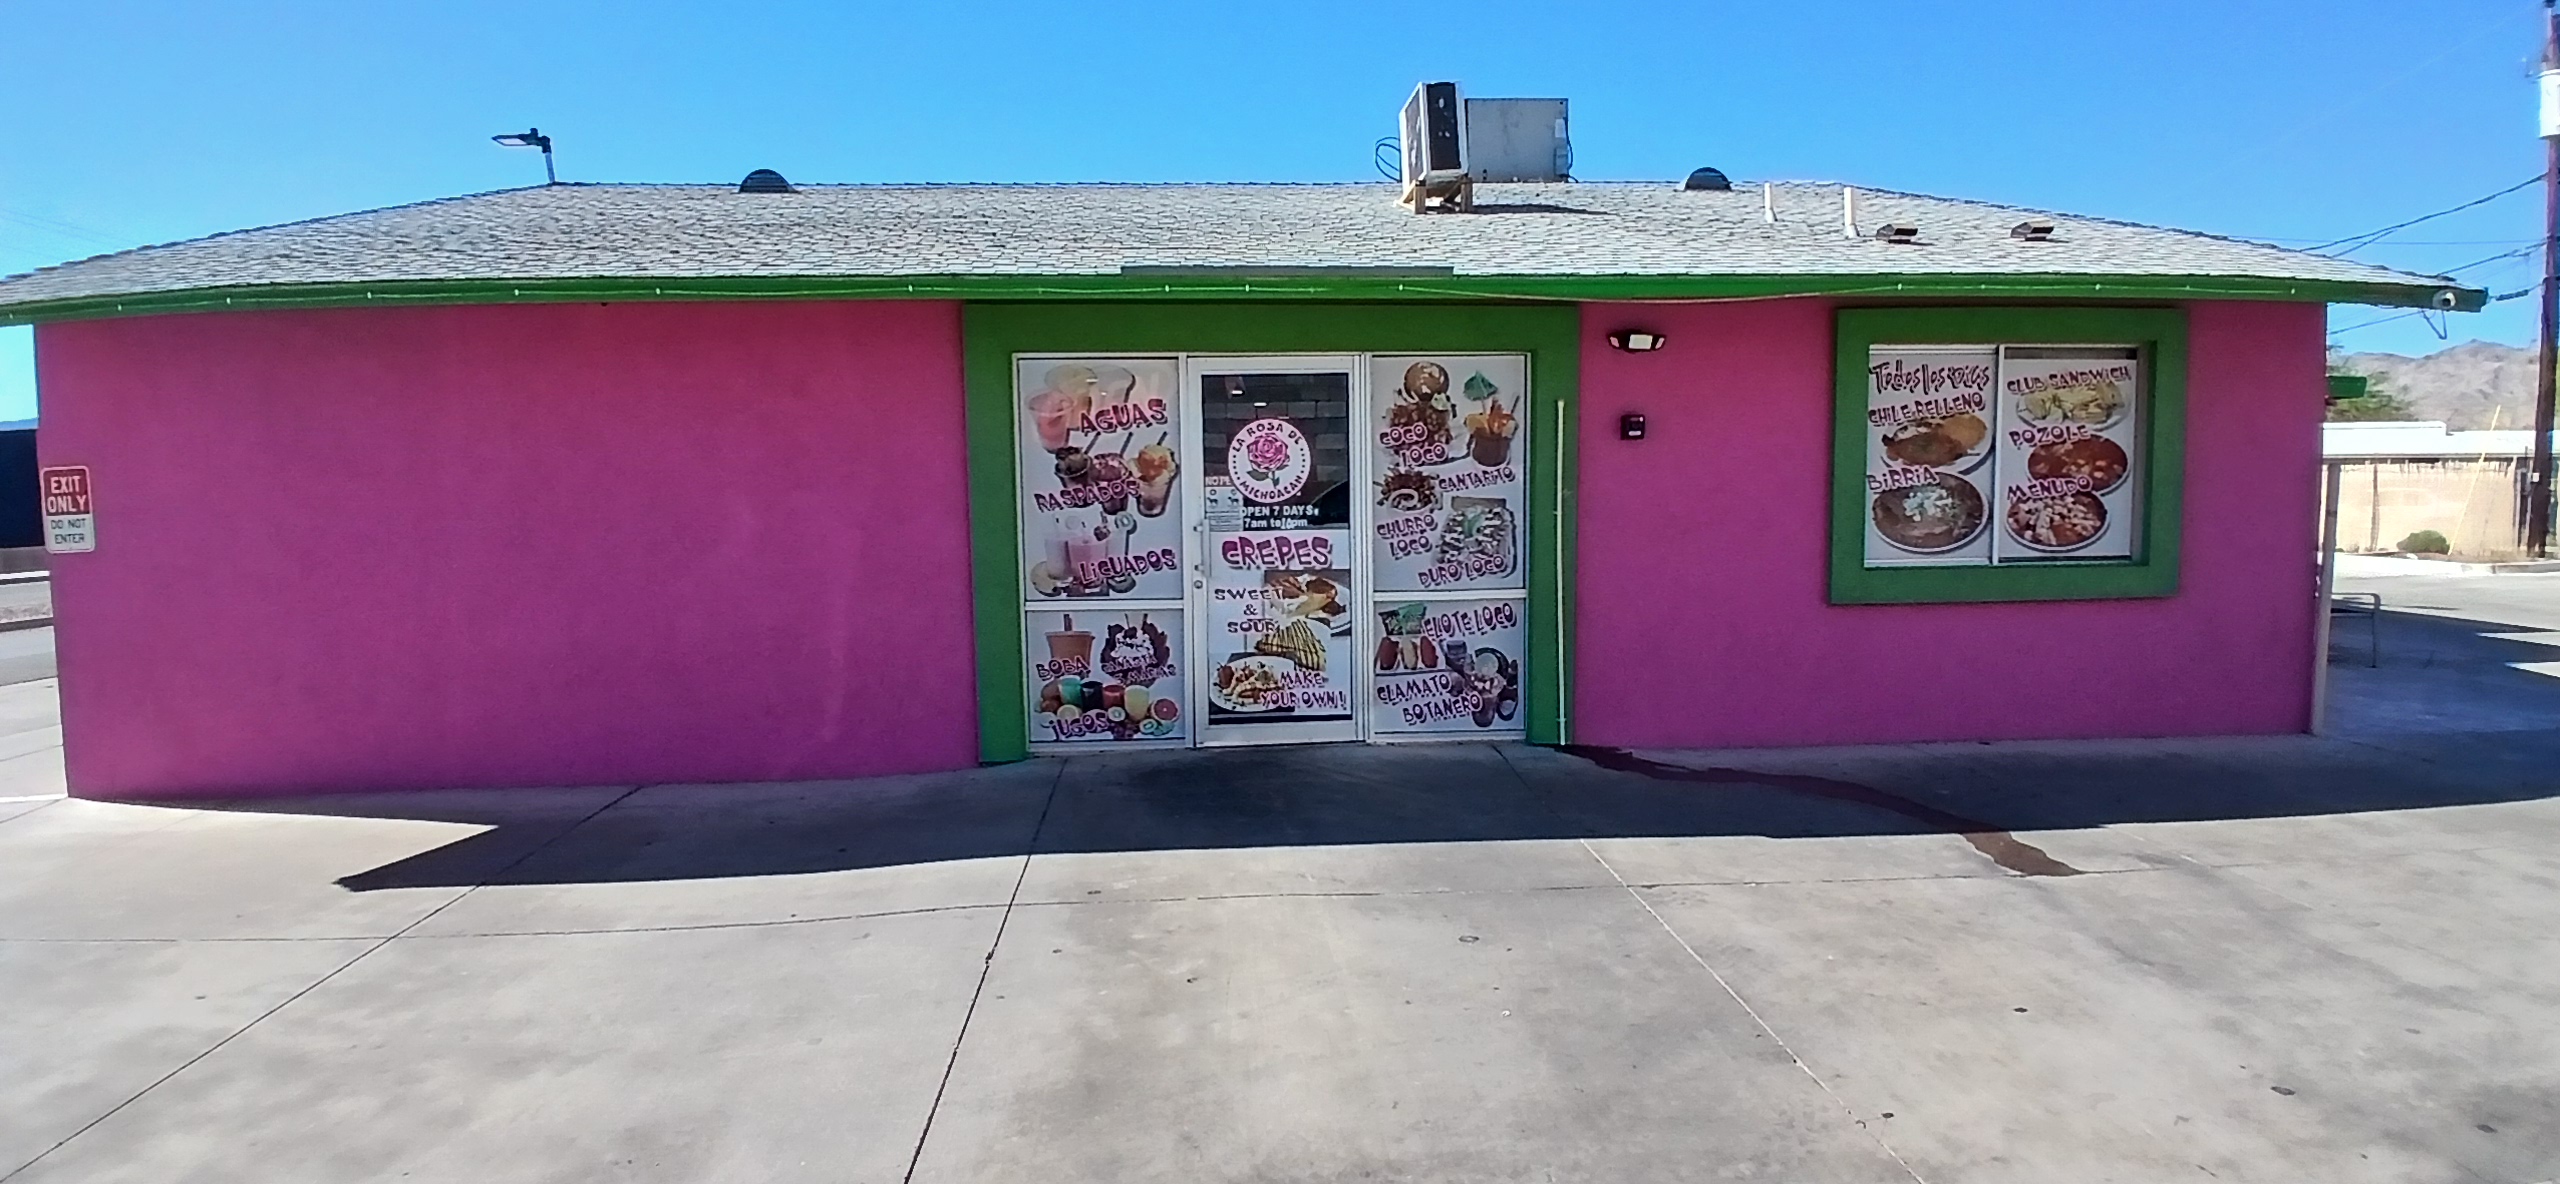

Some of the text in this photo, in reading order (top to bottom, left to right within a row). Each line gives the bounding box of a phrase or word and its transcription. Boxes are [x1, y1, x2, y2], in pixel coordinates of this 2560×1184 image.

[1869, 359, 1920, 394] Todos
[1921, 364, 1945, 395] los
[2007, 377, 2045, 395] CLUB
[1914, 391, 1985, 416] RELLENO
[1079, 398, 1168, 437] AGUAS
[1232, 422, 1304, 453] LA ROSA DE
[1380, 424, 1427, 445] COCO
[2008, 424, 2091, 448] POZOLE
[1402, 444, 1448, 468] LOCO
[50, 475, 81, 494] EXIT
[1034, 480, 1142, 512] RASPADOS
[1239, 475, 1303, 500] MICHOACAN
[2007, 476, 2093, 500] MENUDO
[47, 495, 87, 513] ONLY
[1241, 506, 1270, 516] OPEN
[1273, 506, 1280, 516] 7
[50, 518, 86, 529] DO NOT
[1245, 518, 1267, 528] 7am
[1377, 514, 1437, 538] CHURRO
[55, 533, 85, 544] ENTER
[1389, 535, 1432, 558] LOCO
[1222, 536, 1331, 569] CREPES
[1418, 555, 1507, 587] DURO LOCO
[1214, 587, 1283, 600] SWEET
[1243, 604, 1258, 616] &
[1423, 603, 1517, 639] ELOTE LOCO
[1227, 619, 1279, 634] SOUR
[1036, 655, 1091, 681] BOBA
[1280, 671, 1325, 687] MAKE
[1260, 691, 1299, 708] YOUR
[1377, 674, 1451, 703] CLAMATO
[1402, 693, 1482, 724] BOTANERO
